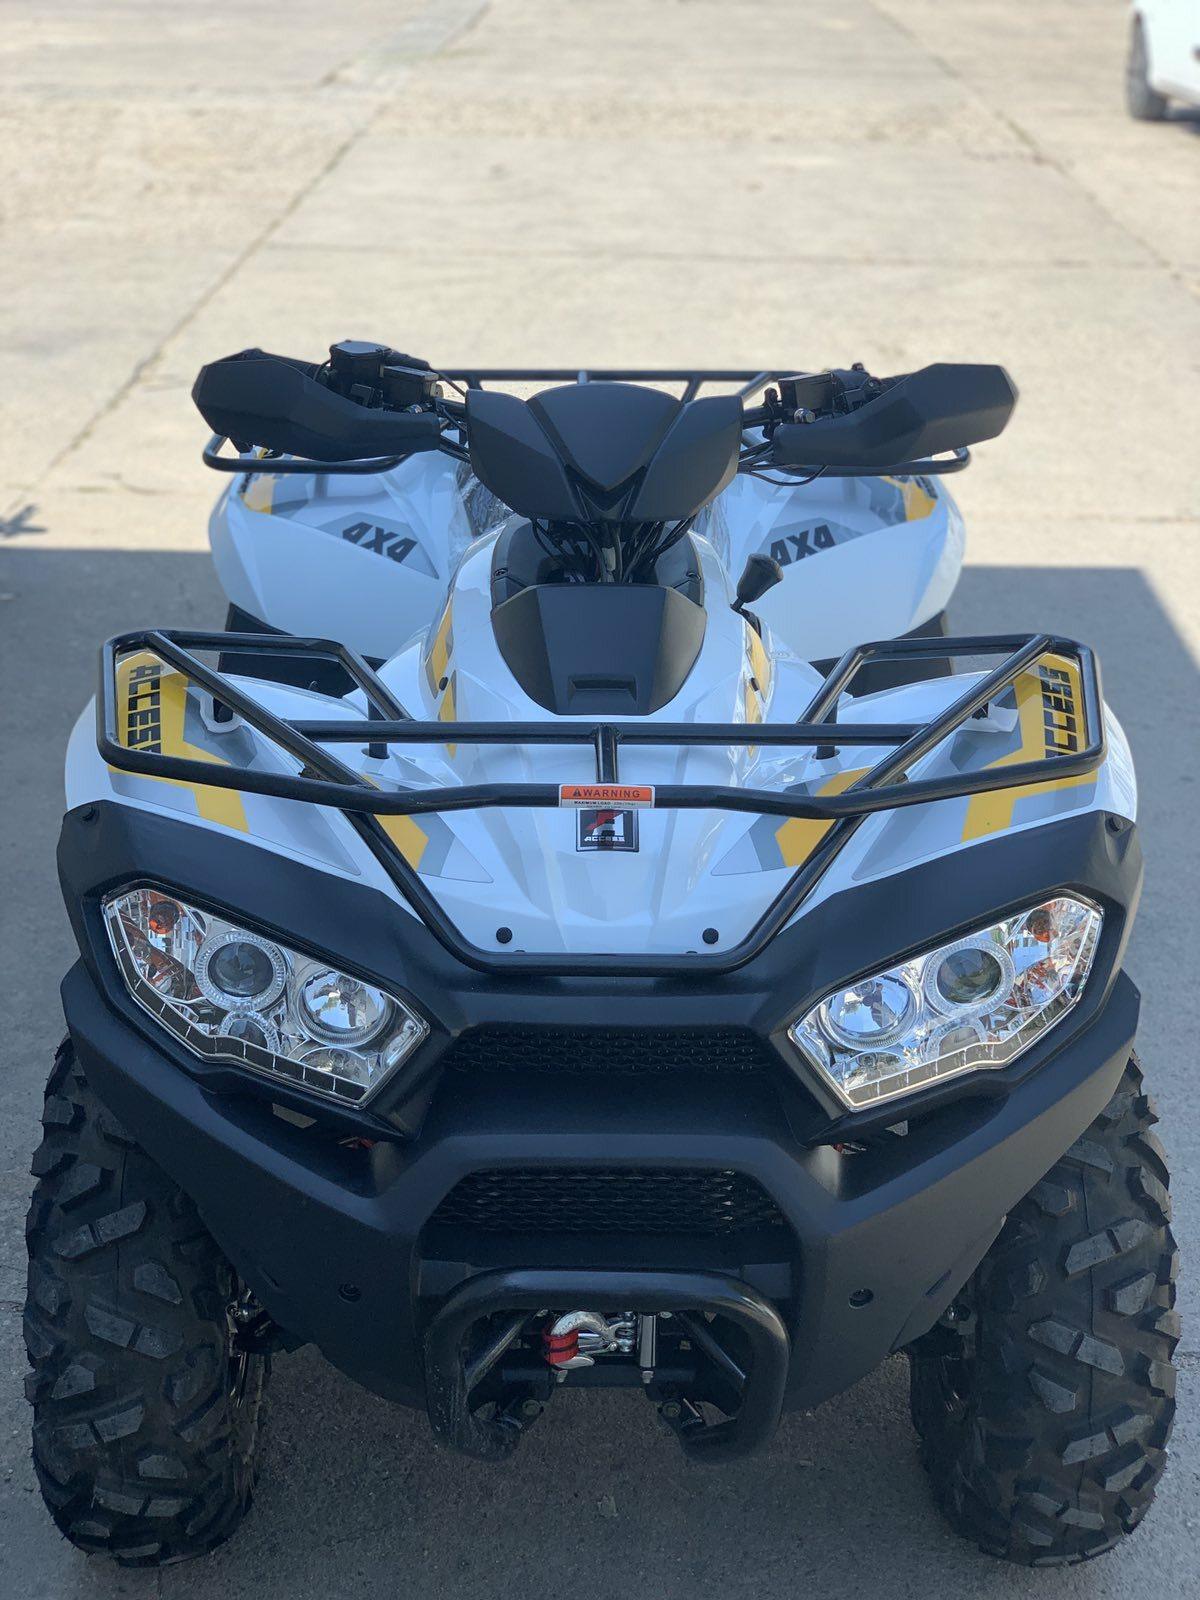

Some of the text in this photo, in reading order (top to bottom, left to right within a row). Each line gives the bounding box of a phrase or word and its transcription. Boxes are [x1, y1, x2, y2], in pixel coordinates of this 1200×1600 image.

[343, 521, 418, 563] 4X4
[770, 524, 836, 567] 4X4
[128, 665, 161, 754] ACCES
[583, 789, 641, 798] WARNING
